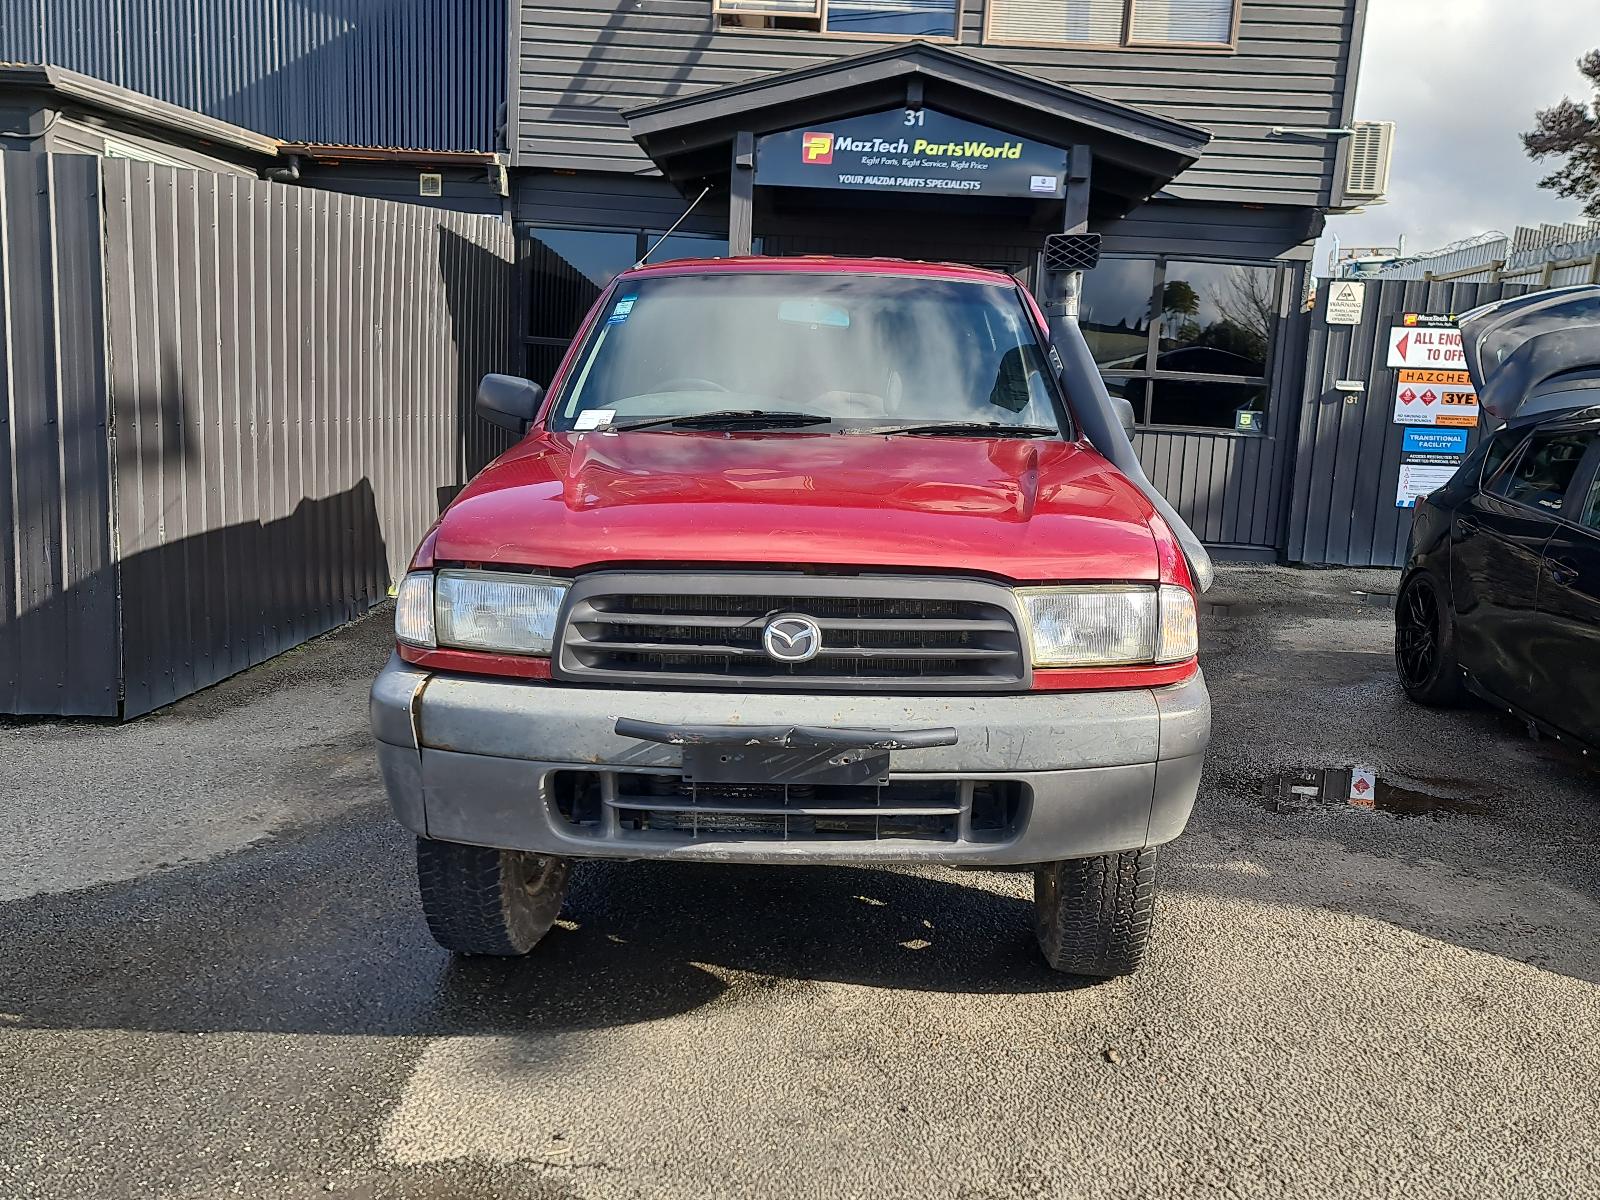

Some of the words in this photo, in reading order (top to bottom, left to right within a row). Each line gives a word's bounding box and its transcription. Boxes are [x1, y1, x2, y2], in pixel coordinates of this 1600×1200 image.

[904, 110, 925, 126] 31
[834, 136, 909, 153] MazTech
[913, 139, 1023, 159] PartsWorld
[861, 156, 880, 166] Right
[880, 157, 900, 166] Parts,
[902, 158, 921, 168] Right
[921, 159, 950, 169] Service,
[951, 160, 970, 170] Right
[970, 161, 989, 170] Price
[839, 174, 863, 184] YOUR
[864, 176, 895, 186] MAZDA
[896, 177, 925, 187] PARTS
[925, 178, 981, 190] SPECIALISTS
[1414, 332, 1434, 345] ALL
[1438, 333, 1462, 347] ENQ
[1427, 348, 1441, 361] TO
[1443, 349, 1464, 361] OFF
[1346, 395, 1358, 404] 31
[1445, 393, 1475, 405] 3YE
[1410, 434, 1462, 442] TRANSITIONAL
